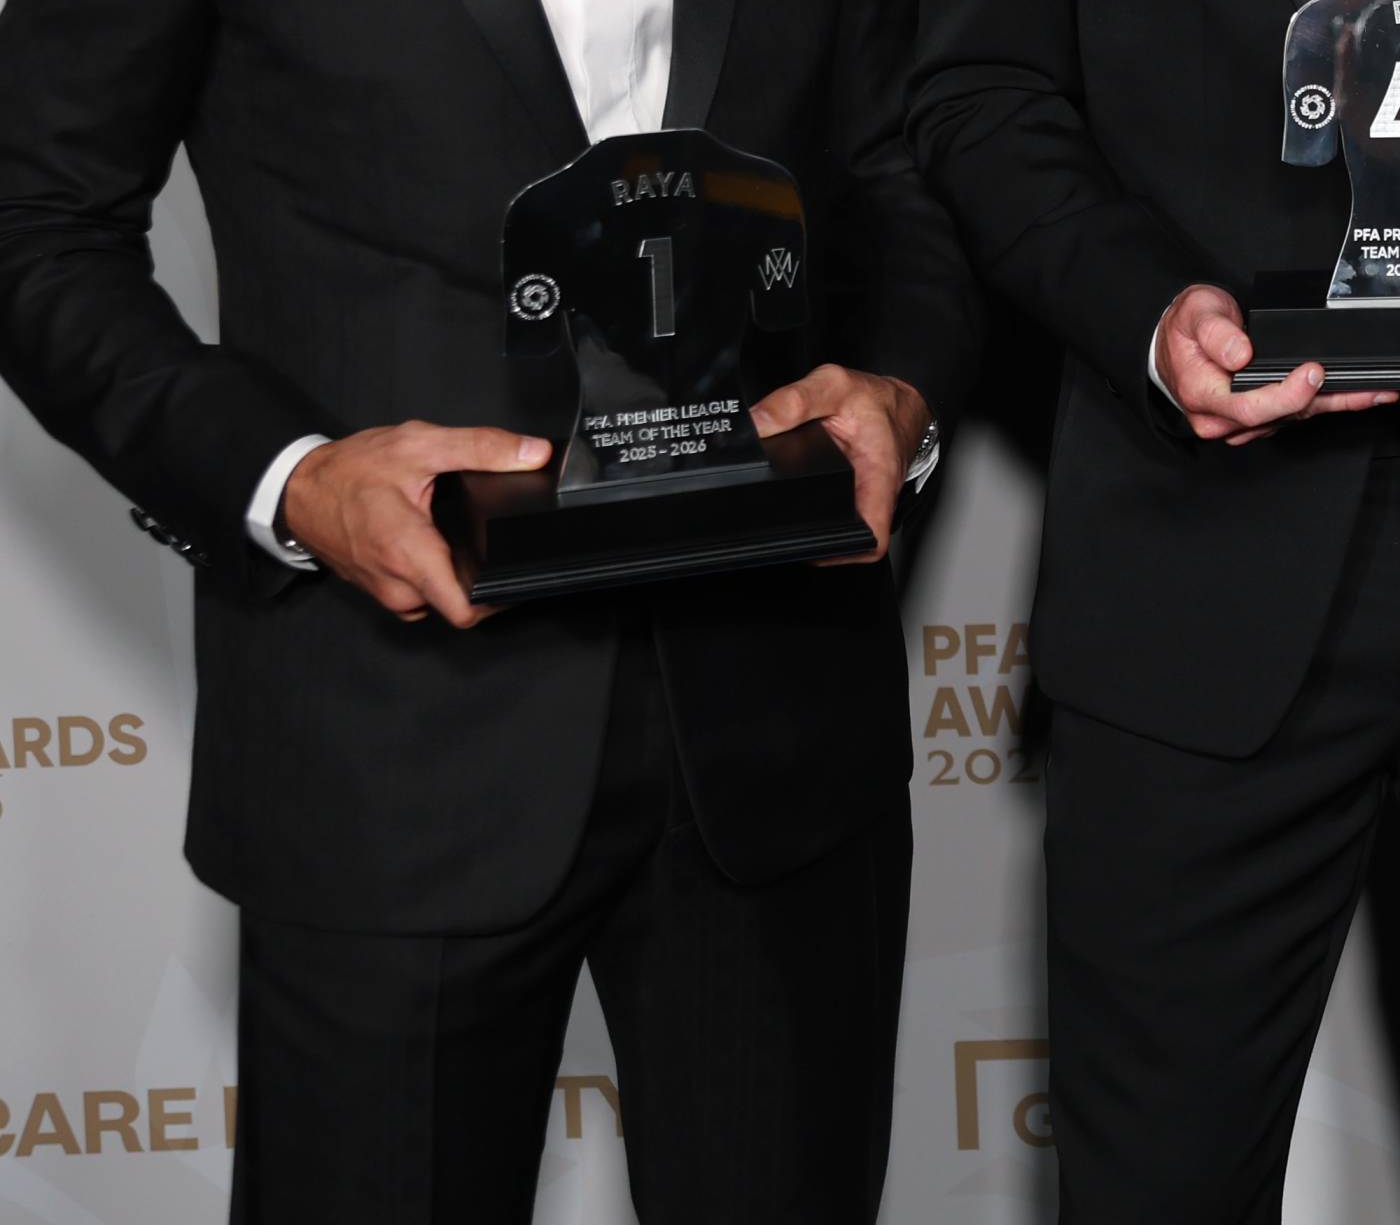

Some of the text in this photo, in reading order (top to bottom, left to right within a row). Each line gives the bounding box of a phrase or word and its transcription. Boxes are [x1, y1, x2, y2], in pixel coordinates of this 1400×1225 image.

[610, 172, 697, 206] RAYA
[1354, 229, 1379, 241] PFA
[1361, 246, 1400, 259] TEAM
[638, 236, 675, 338] 1
[584, 400, 739, 430] PFA PREMIER LEAGUE
[592, 419, 732, 448] TEAM OF THE YEAR
[619, 445, 656, 463] 2025
[670, 439, 707, 456] 2026
[0, 713, 148, 770] RDS
[927, 748, 1041, 786] 202
